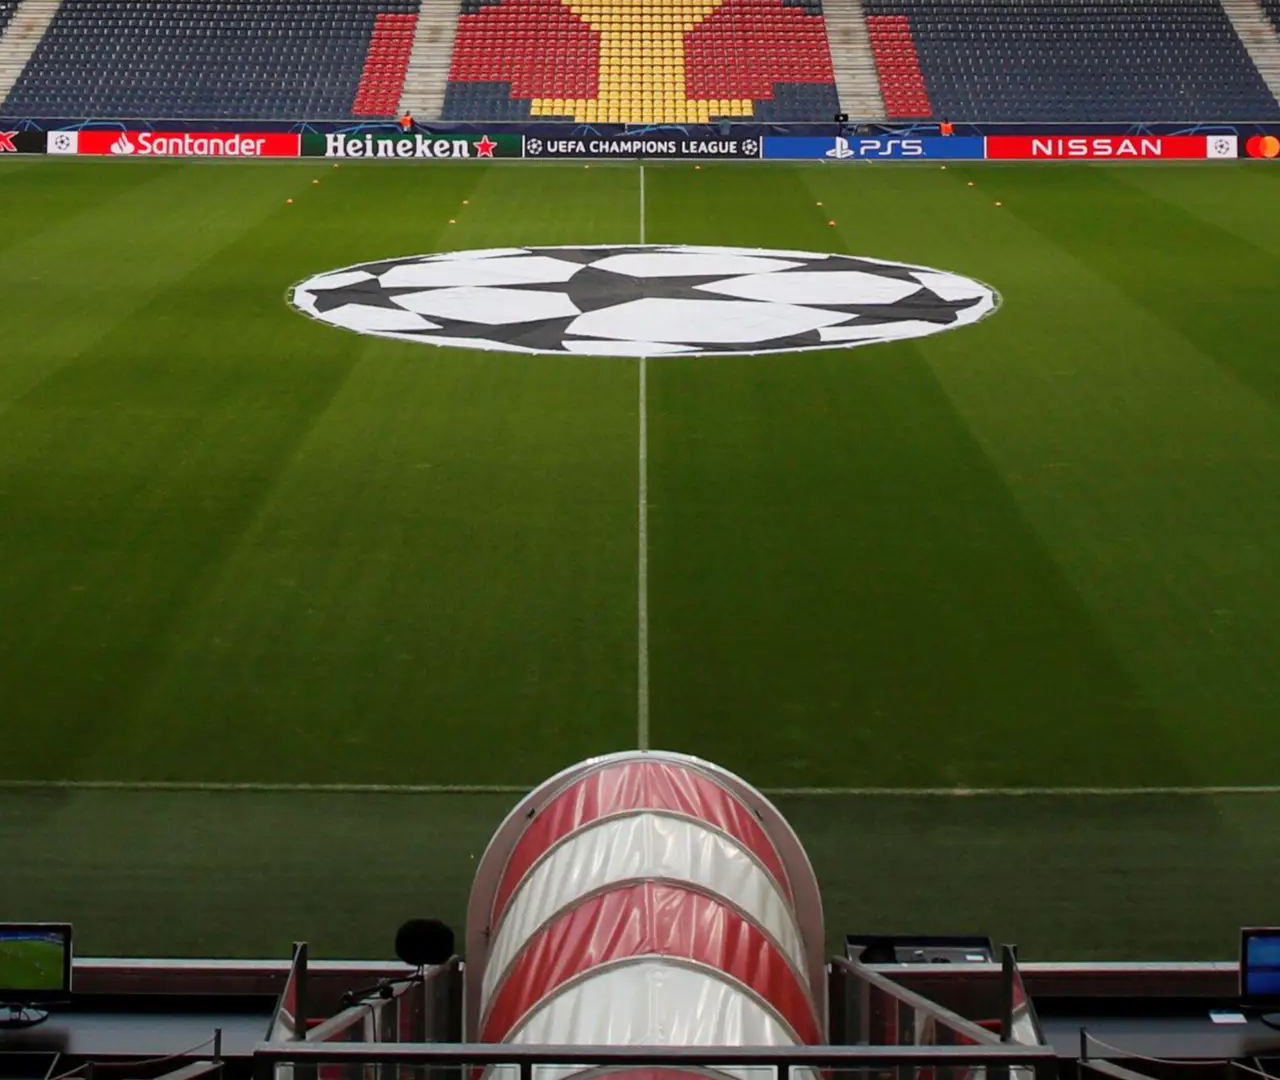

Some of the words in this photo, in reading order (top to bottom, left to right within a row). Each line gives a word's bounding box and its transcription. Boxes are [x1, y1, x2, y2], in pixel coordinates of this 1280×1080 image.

[137, 132, 265, 155] Santander
[325, 134, 470, 158] Heineken
[547, 139, 585, 154] UEFA
[590, 139, 676, 155] CHAMPIONS
[681, 140, 737, 156] LEAGUE
[860, 140, 923, 155] PS5
[1032, 139, 1162, 156] NISSAN
